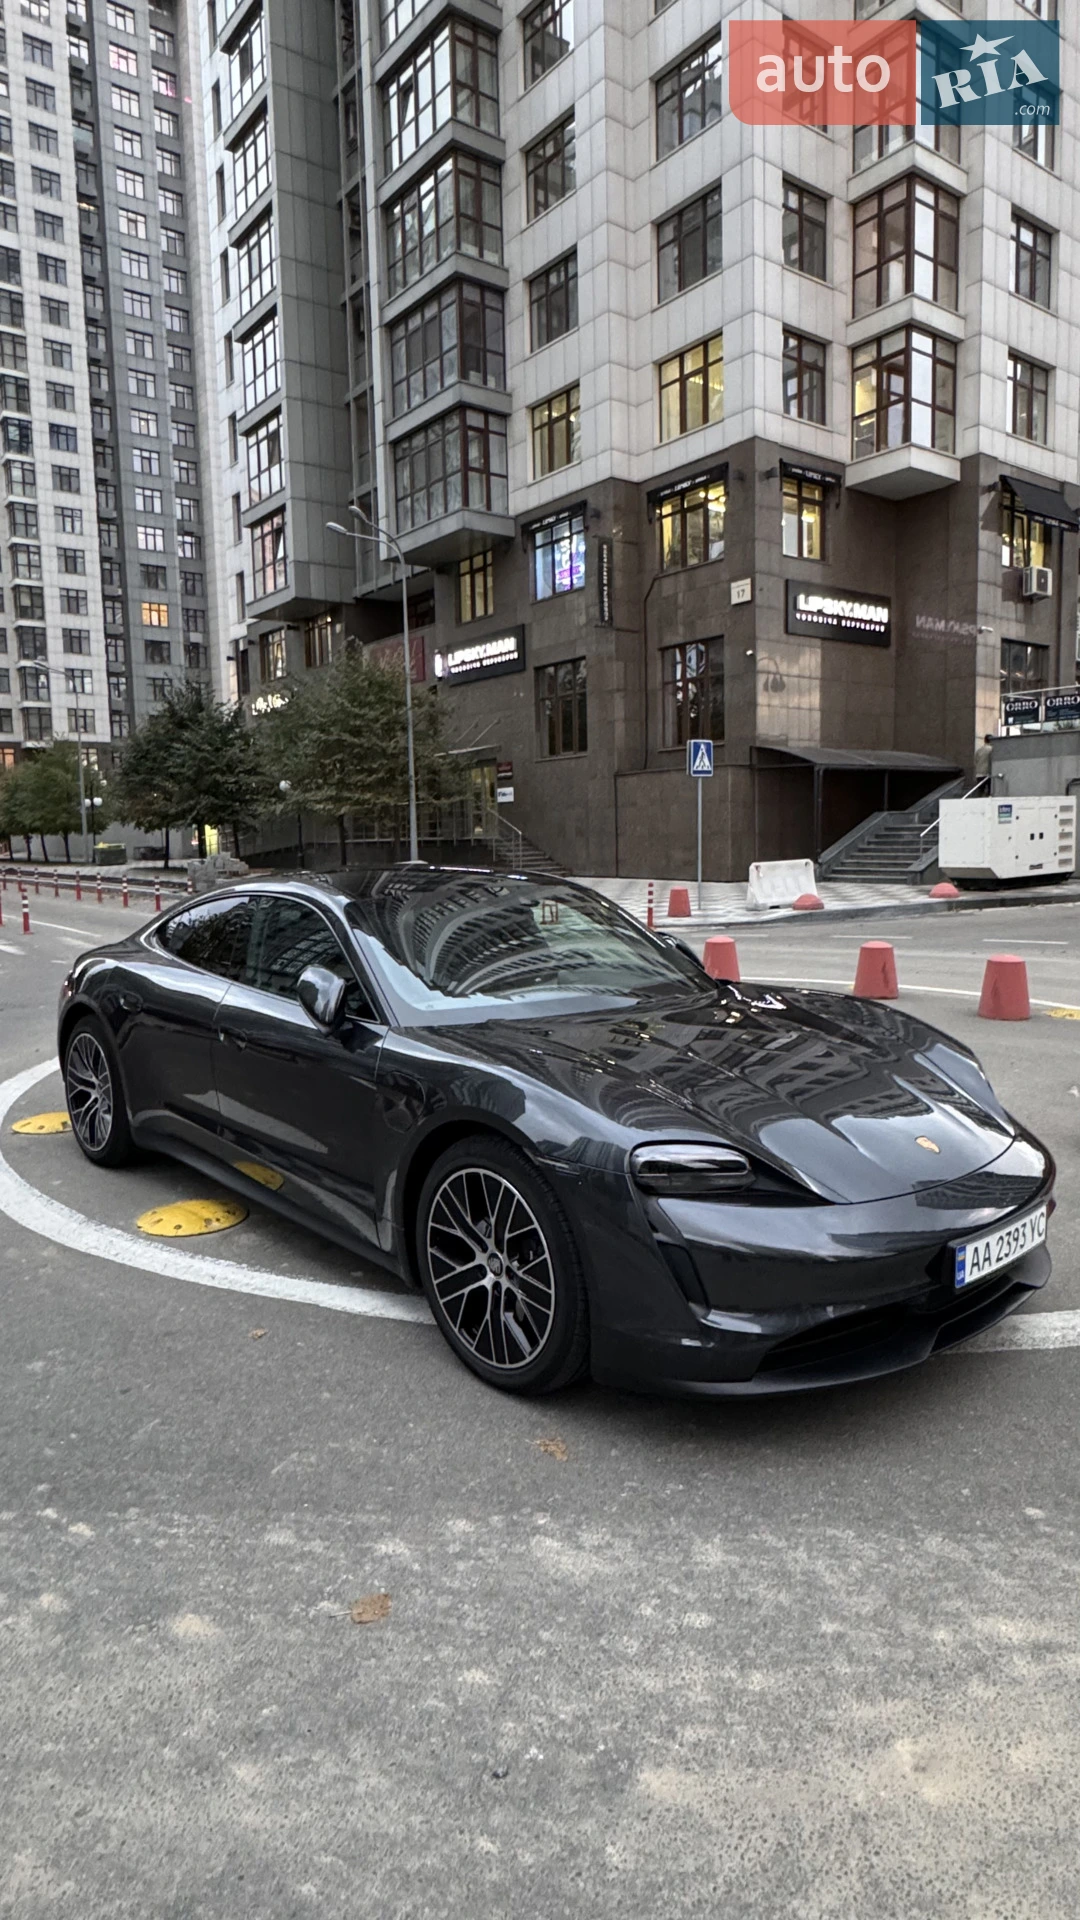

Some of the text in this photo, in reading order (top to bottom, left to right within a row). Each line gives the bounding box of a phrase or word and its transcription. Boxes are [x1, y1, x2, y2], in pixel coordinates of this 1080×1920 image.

[737, 588, 745, 600] 17
[796, 594, 889, 623] LIPSKY.MAN
[448, 636, 518, 667] LIPSKY.MAN
[1006, 700, 1039, 712] ORRO
[969, 1211, 1045, 1276] AA 2393 YC
